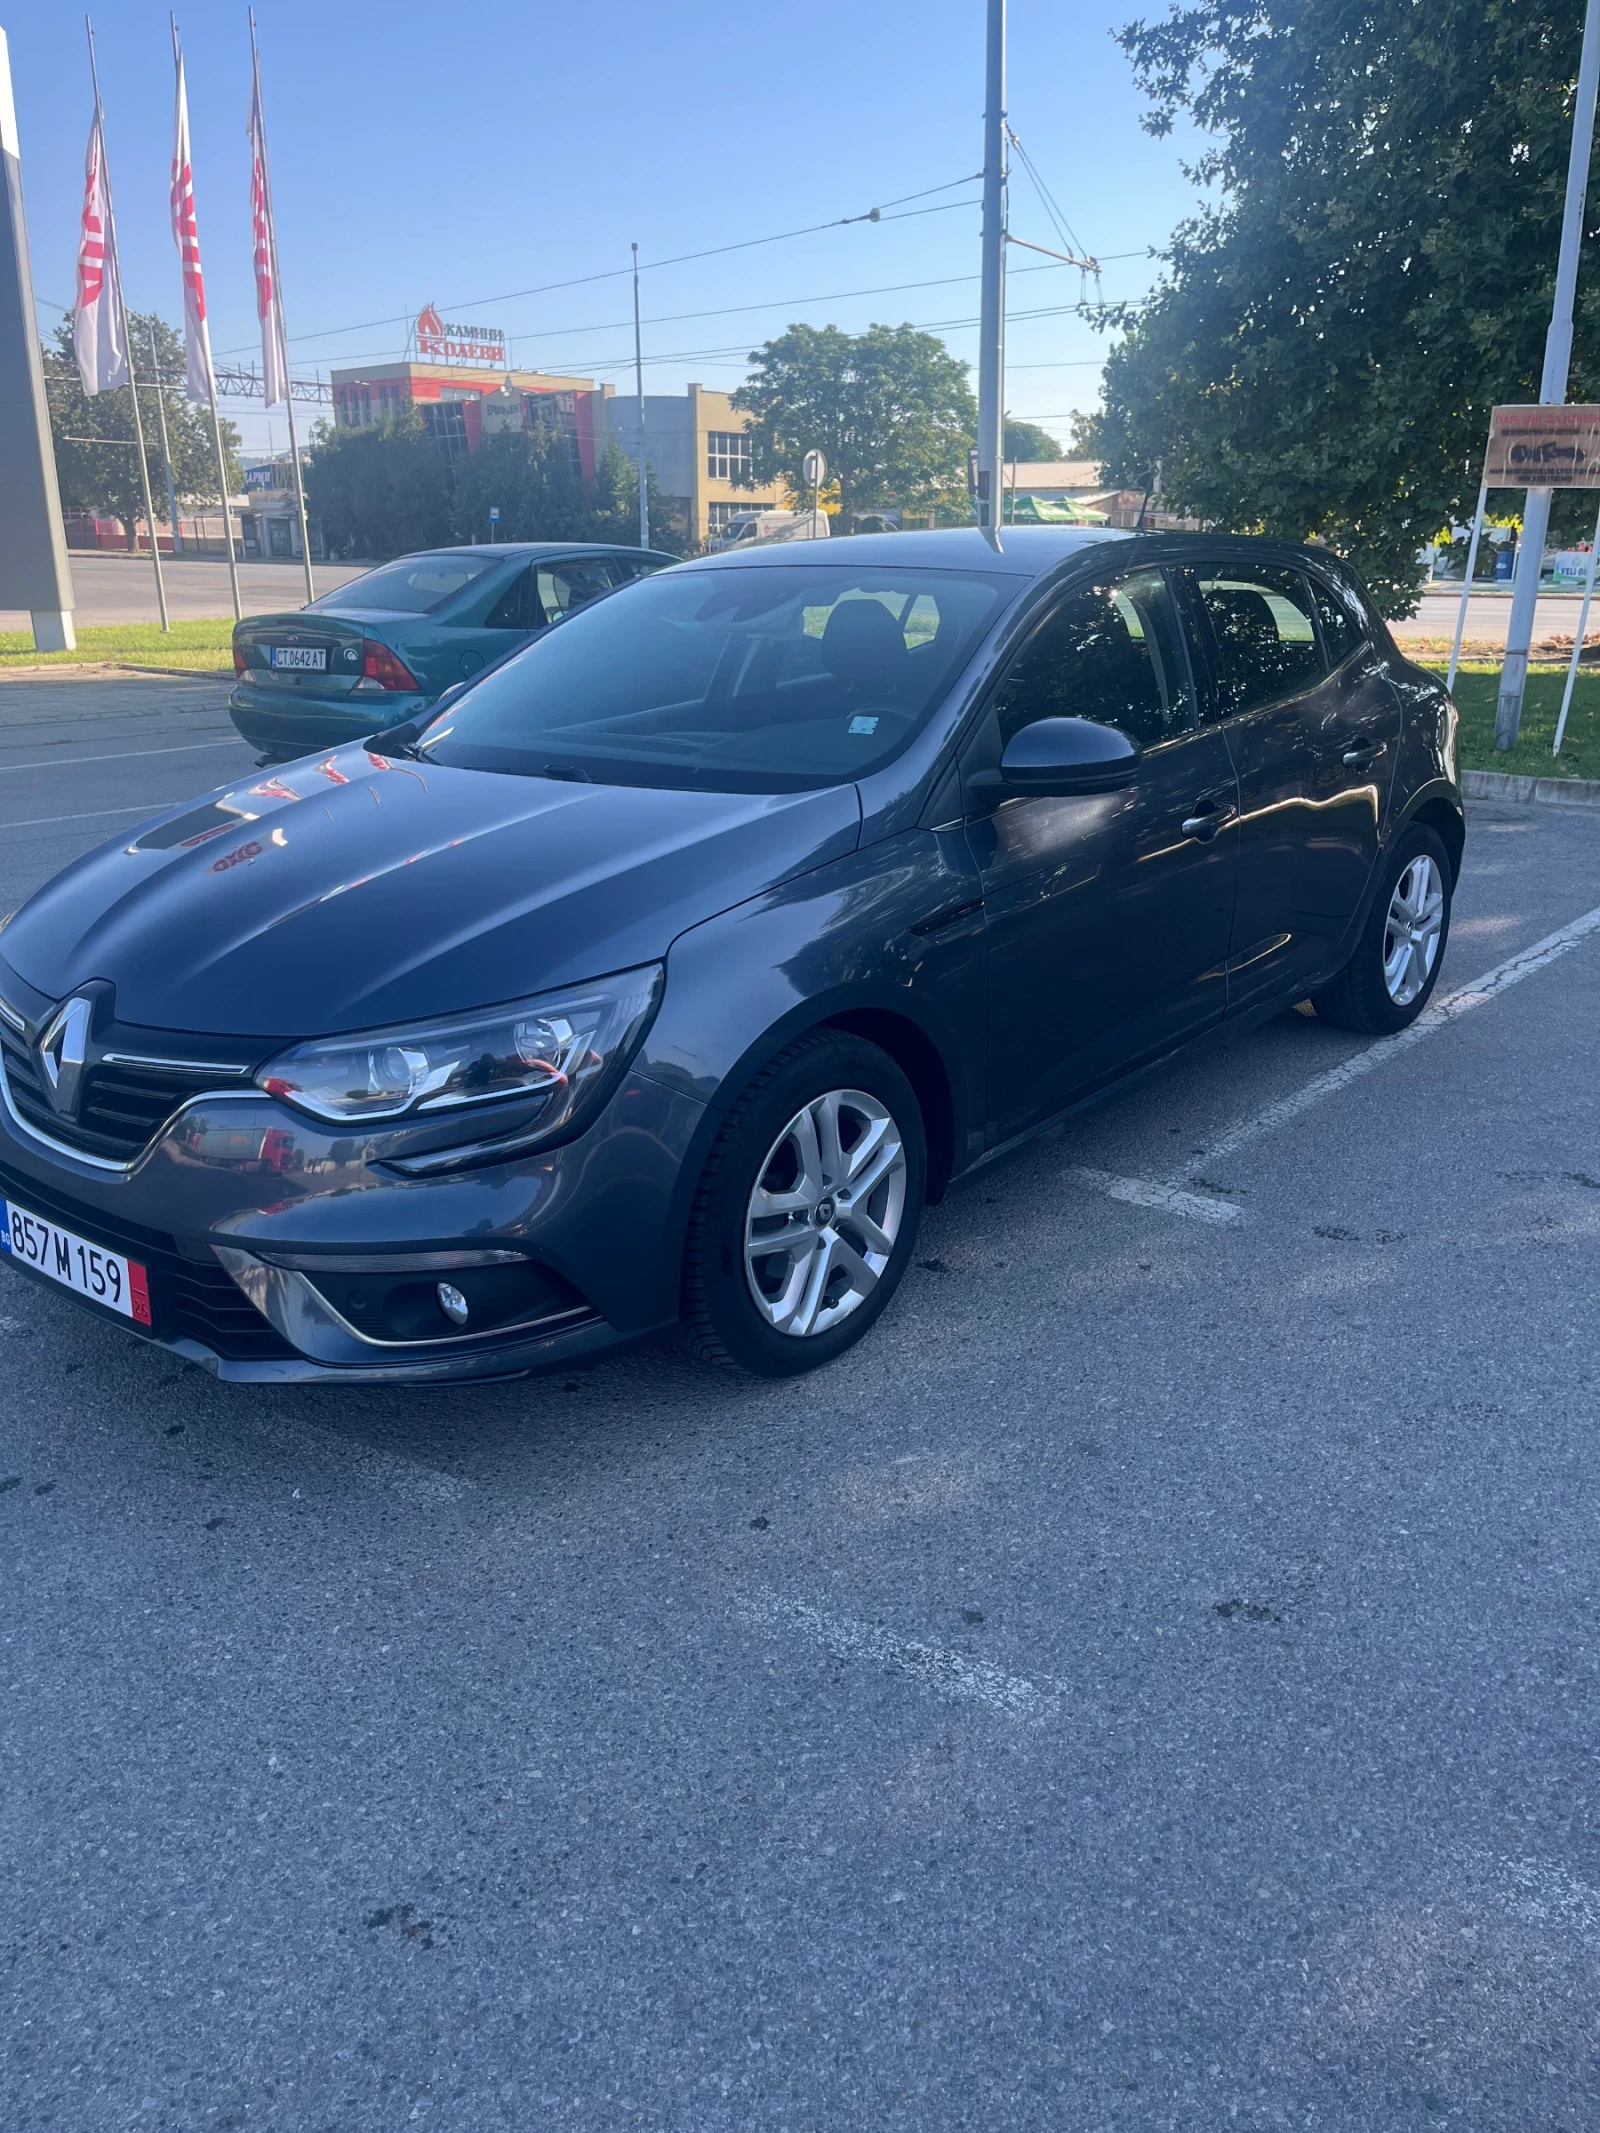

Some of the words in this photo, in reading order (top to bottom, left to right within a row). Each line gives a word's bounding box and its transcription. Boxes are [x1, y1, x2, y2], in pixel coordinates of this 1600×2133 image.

[445, 323, 504, 341] КАМИНИ
[1547, 415, 1560, 424] ЗА
[0, 1229, 11, 1246] BG
[12, 1210, 49, 1267] 857
[53, 1231, 72, 1281] M
[76, 1244, 121, 1303] 159
[133, 1299, 148, 1317] 26
